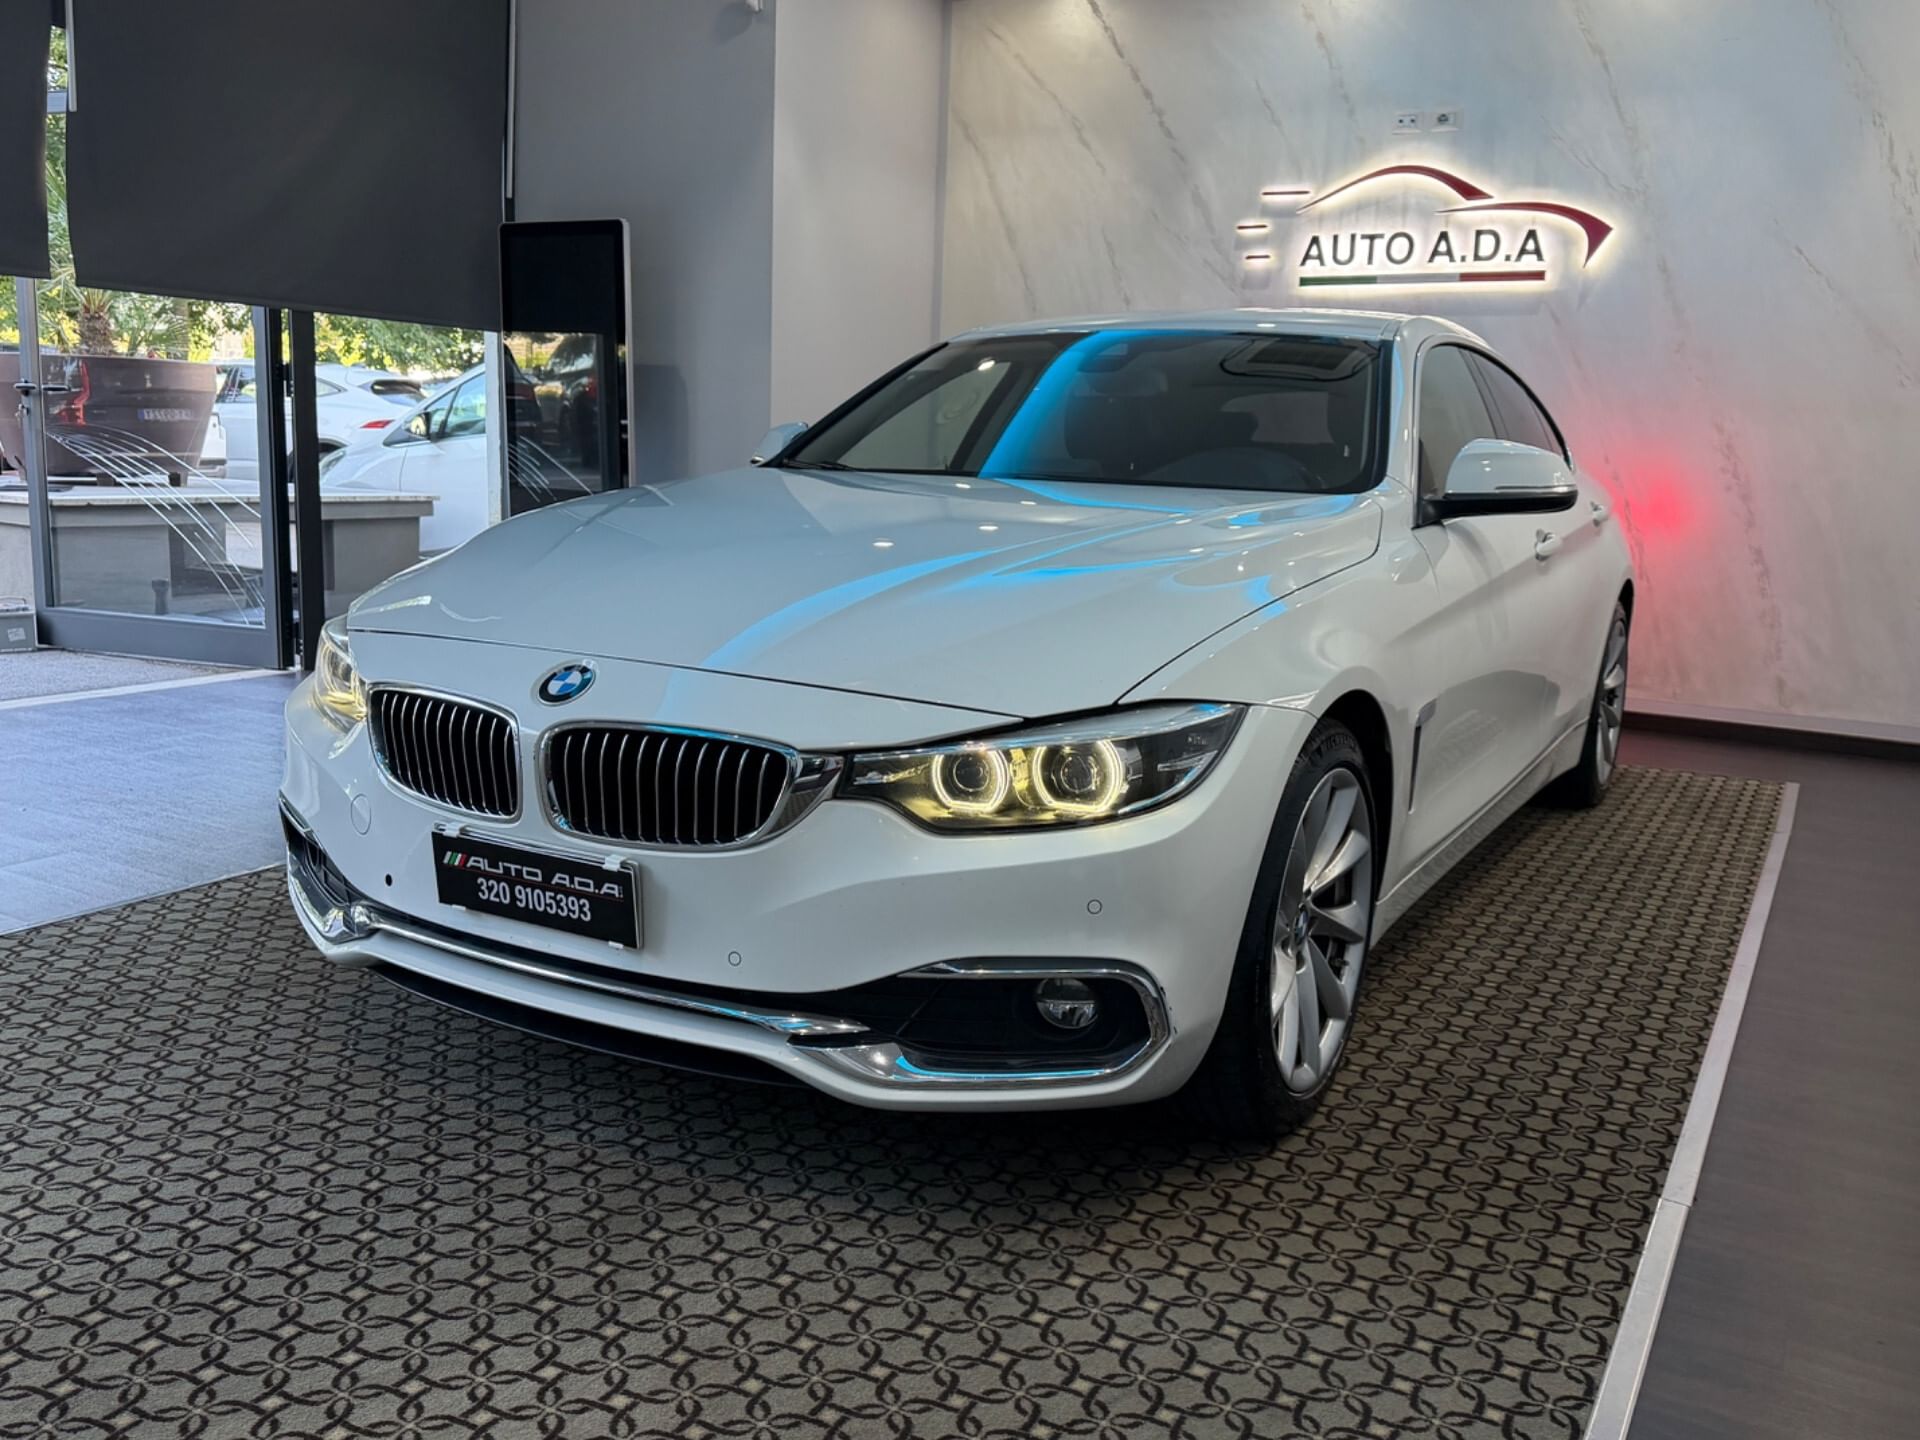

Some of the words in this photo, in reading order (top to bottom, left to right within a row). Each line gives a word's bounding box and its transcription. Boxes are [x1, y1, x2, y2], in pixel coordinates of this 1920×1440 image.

[1300, 230, 1415, 266] AUTO
[1428, 229, 1544, 263] A.D.A
[466, 856, 542, 882] AUTO
[477, 878, 510, 904] 320
[515, 885, 591, 922] 9105393
